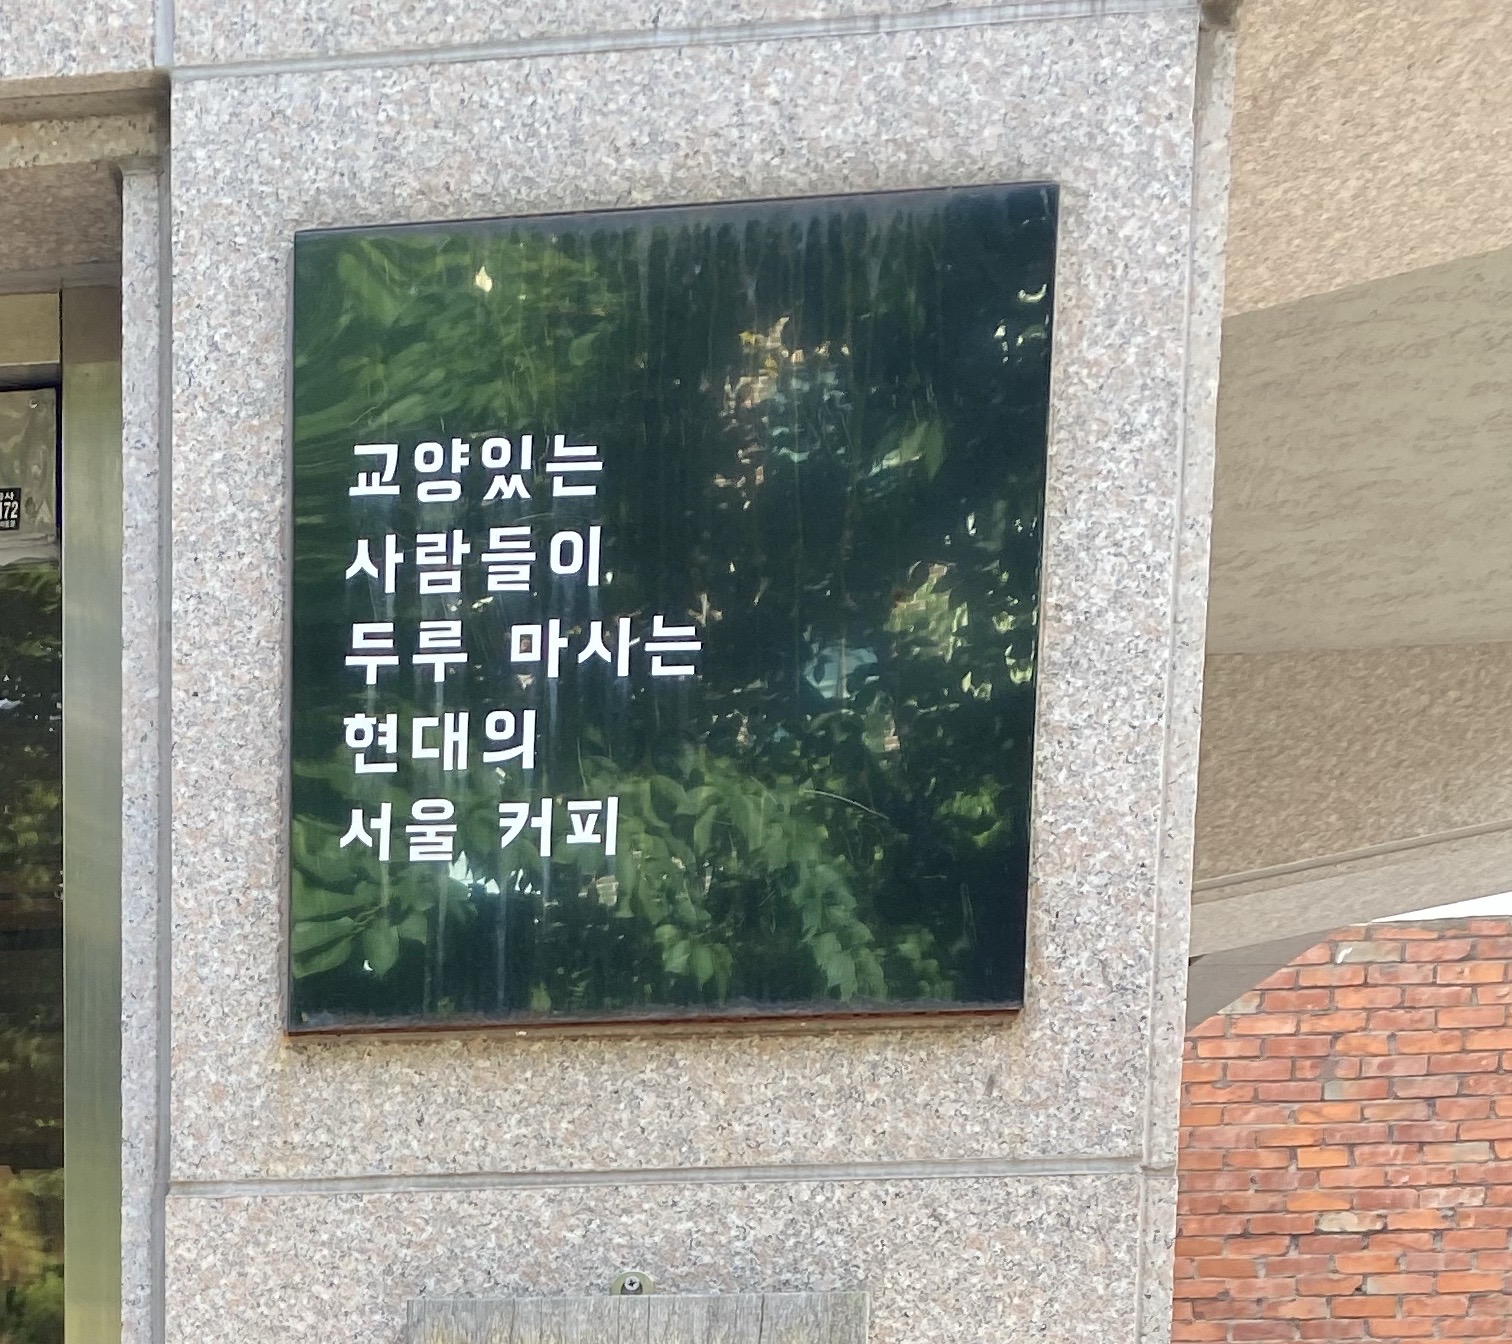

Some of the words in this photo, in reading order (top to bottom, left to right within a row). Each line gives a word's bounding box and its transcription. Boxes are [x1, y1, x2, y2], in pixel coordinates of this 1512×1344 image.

[348, 434, 604, 503] 교양있는
[345, 525, 602, 594] 사람들이
[345, 620, 469, 685] 두루
[510, 614, 703, 680] 마사는
[343, 709, 537, 774] 현대의
[339, 798, 458, 863] 서울
[498, 795, 619, 858] 커피
